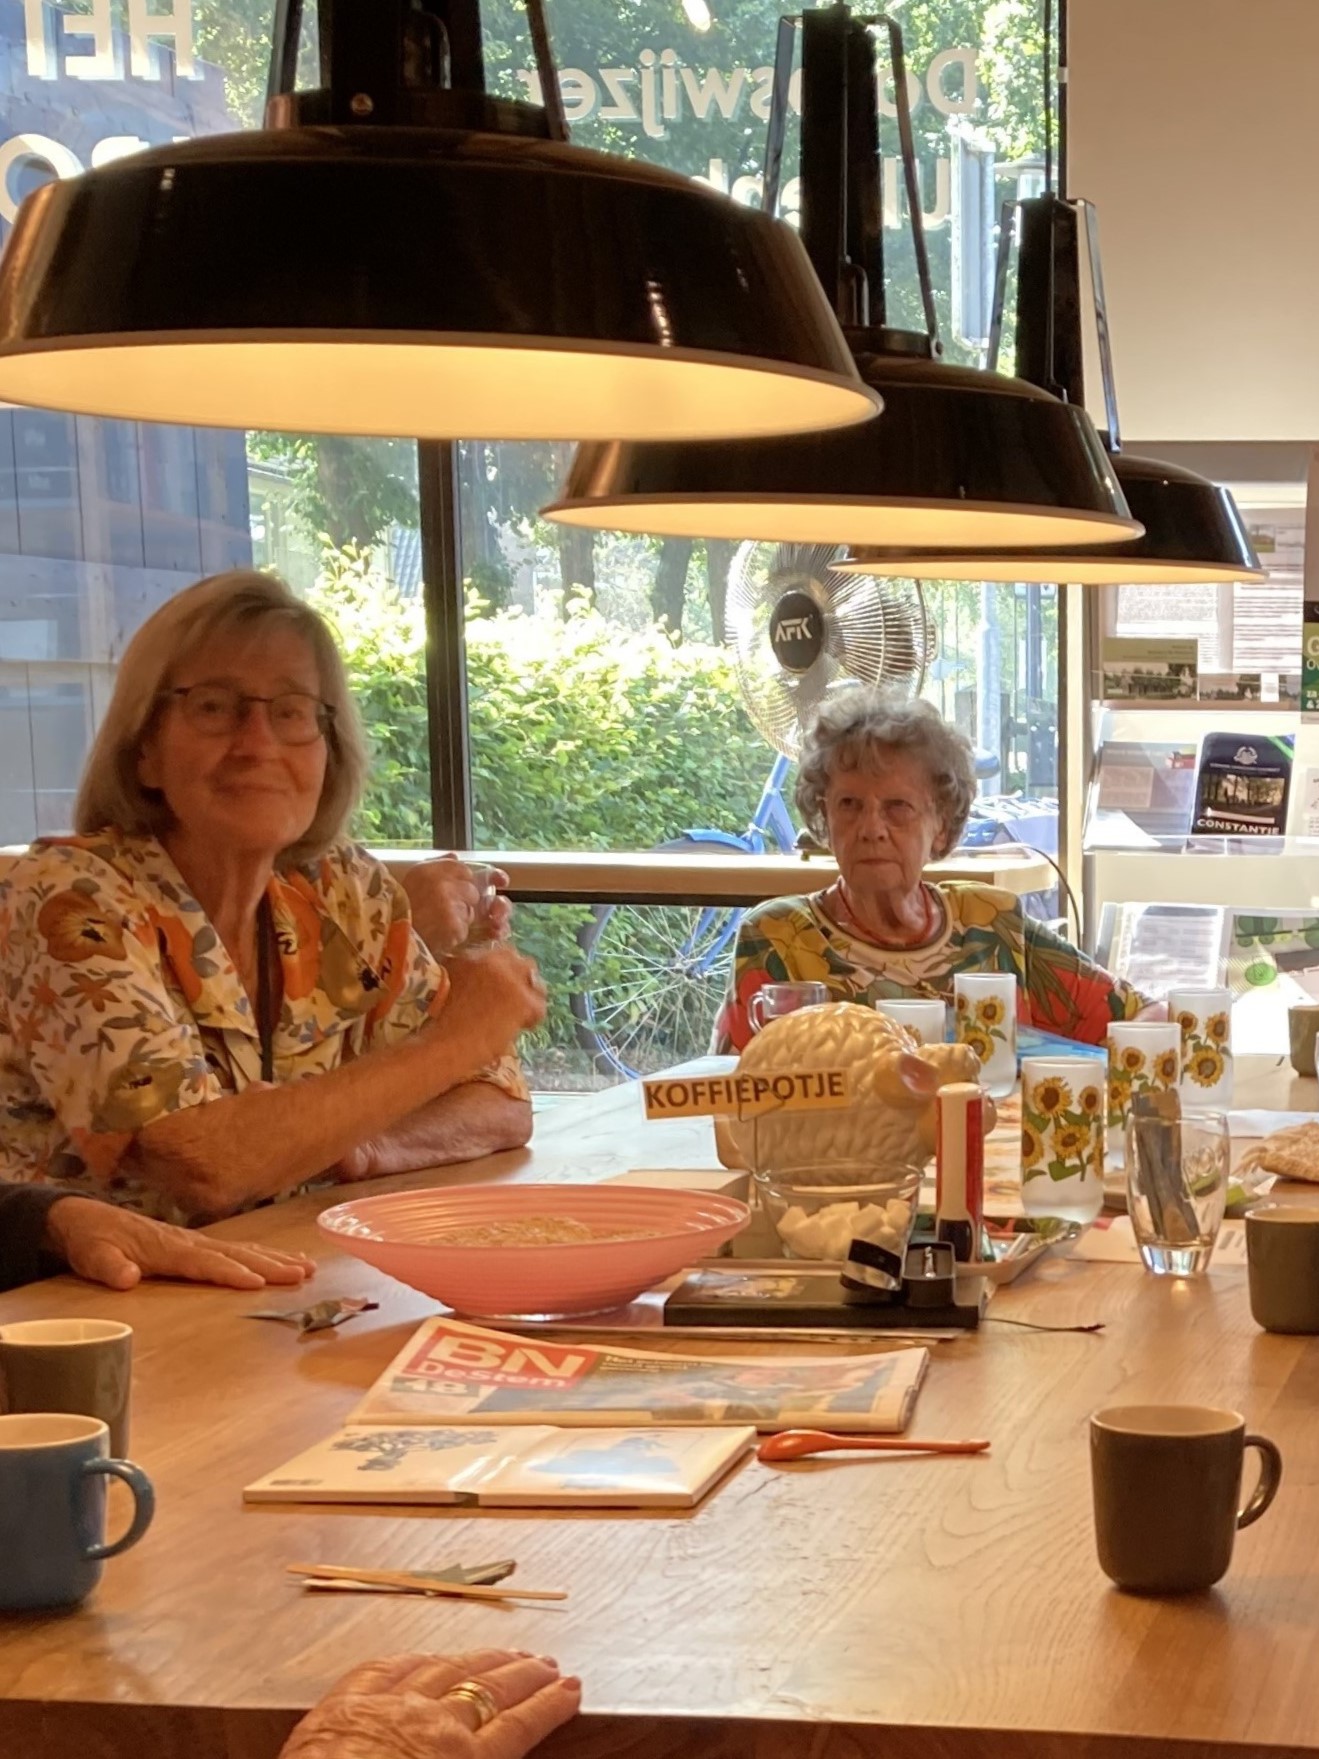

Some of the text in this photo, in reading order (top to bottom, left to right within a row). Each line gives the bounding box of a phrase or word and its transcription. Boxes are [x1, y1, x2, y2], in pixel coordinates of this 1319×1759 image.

[775, 617, 813, 642] AFK
[1306, 701, 1314, 710] &
[645, 1072, 845, 1109] KOFFIEPOTJE
[428, 1335, 587, 1378] BN
[416, 1359, 569, 1389] DeStem
